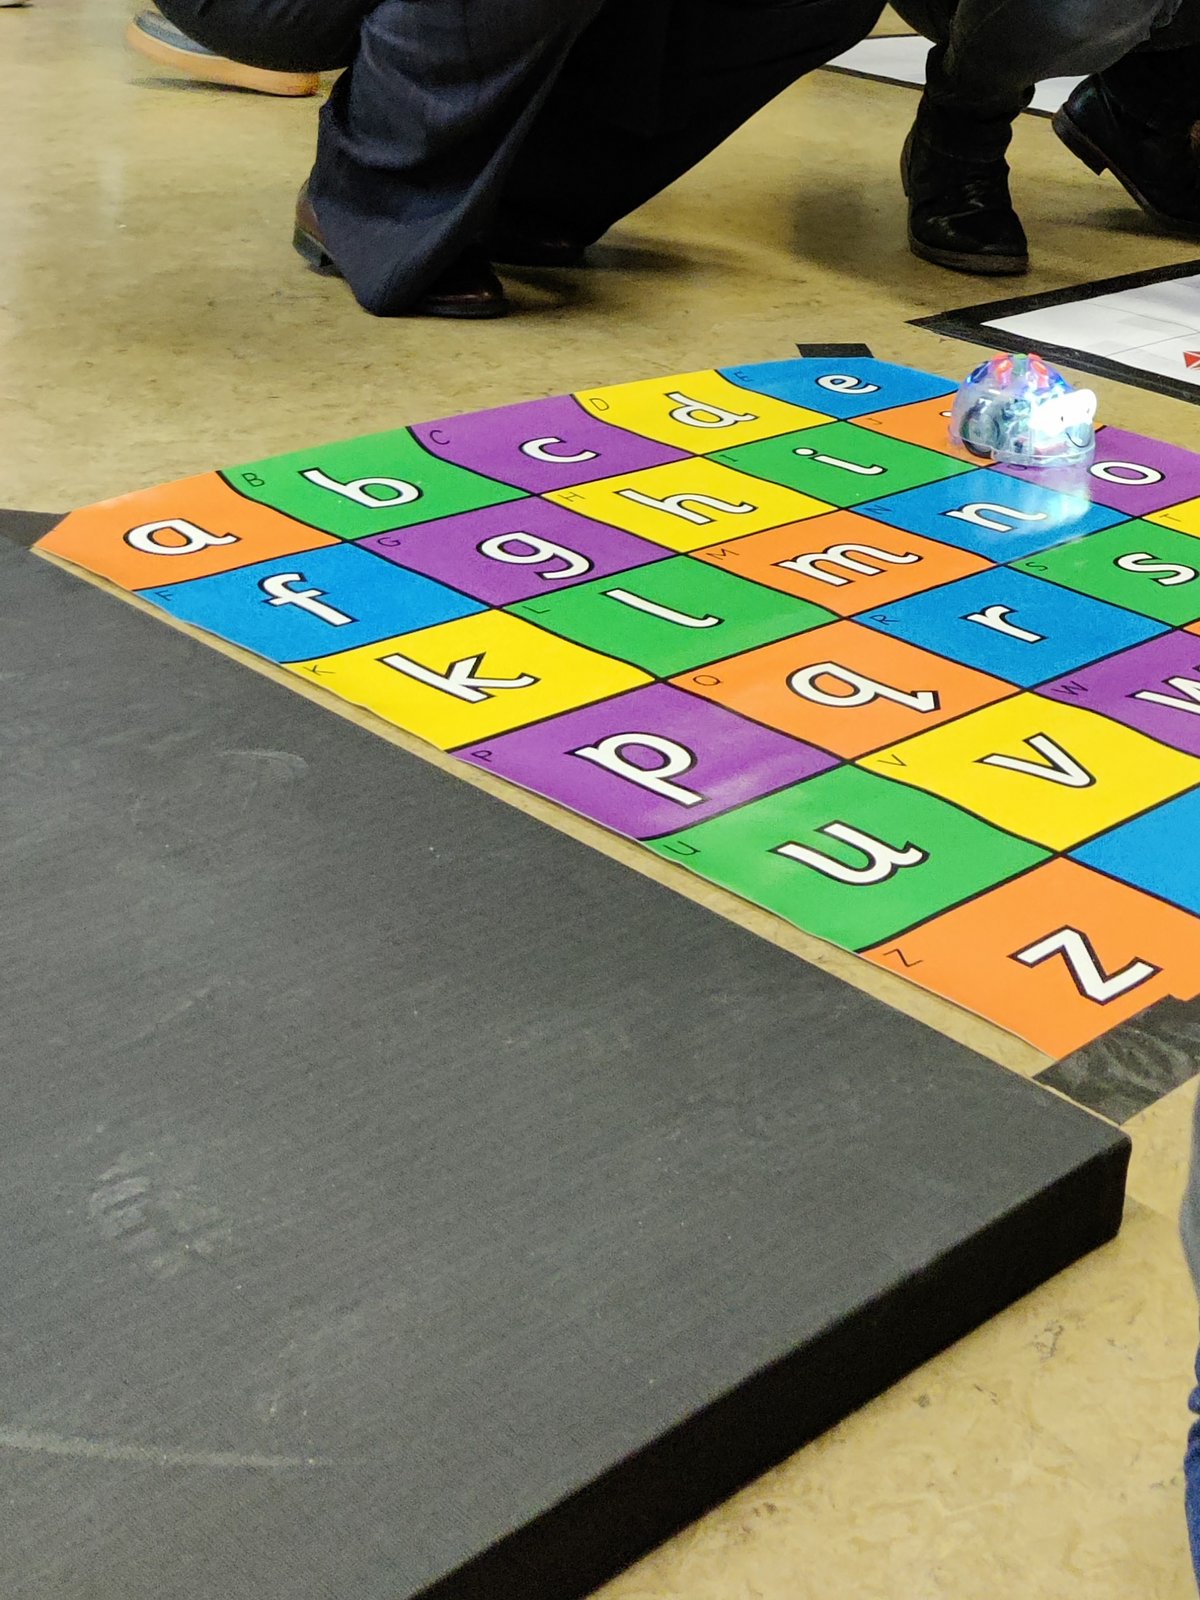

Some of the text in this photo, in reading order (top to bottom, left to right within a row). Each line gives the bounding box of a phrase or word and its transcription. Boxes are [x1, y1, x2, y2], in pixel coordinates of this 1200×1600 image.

[815, 374, 880, 394] e
[589, 398, 609, 411] D
[663, 391, 758, 428] d
[518, 436, 601, 463] c
[792, 447, 887, 476] i
[242, 472, 265, 487] B
[298, 467, 423, 509] b
[1088, 461, 1165, 486] o
[559, 491, 585, 502] H
[613, 488, 758, 525] h
[863, 504, 893, 515] N
[938, 502, 1047, 532] n
[1159, 513, 1182, 522] T
[123, 518, 242, 555] a
[377, 536, 401, 547] G
[476, 531, 595, 580] g
[706, 548, 739, 560] M
[770, 543, 923, 587] m
[1113, 552, 1200, 587] s
[154, 590, 173, 601] F
[258, 572, 360, 627] f
[522, 606, 551, 614] L
[599, 588, 725, 628] l
[869, 614, 899, 625] R
[959, 604, 1048, 644] r
[303, 664, 335, 676] K
[374, 652, 541, 704] k
[786, 661, 941, 713] q
[470, 750, 493, 762] P
[564, 731, 712, 808] p
[973, 732, 1096, 788] v
[767, 820, 930, 885] u
[1006, 924, 1163, 1006] z
